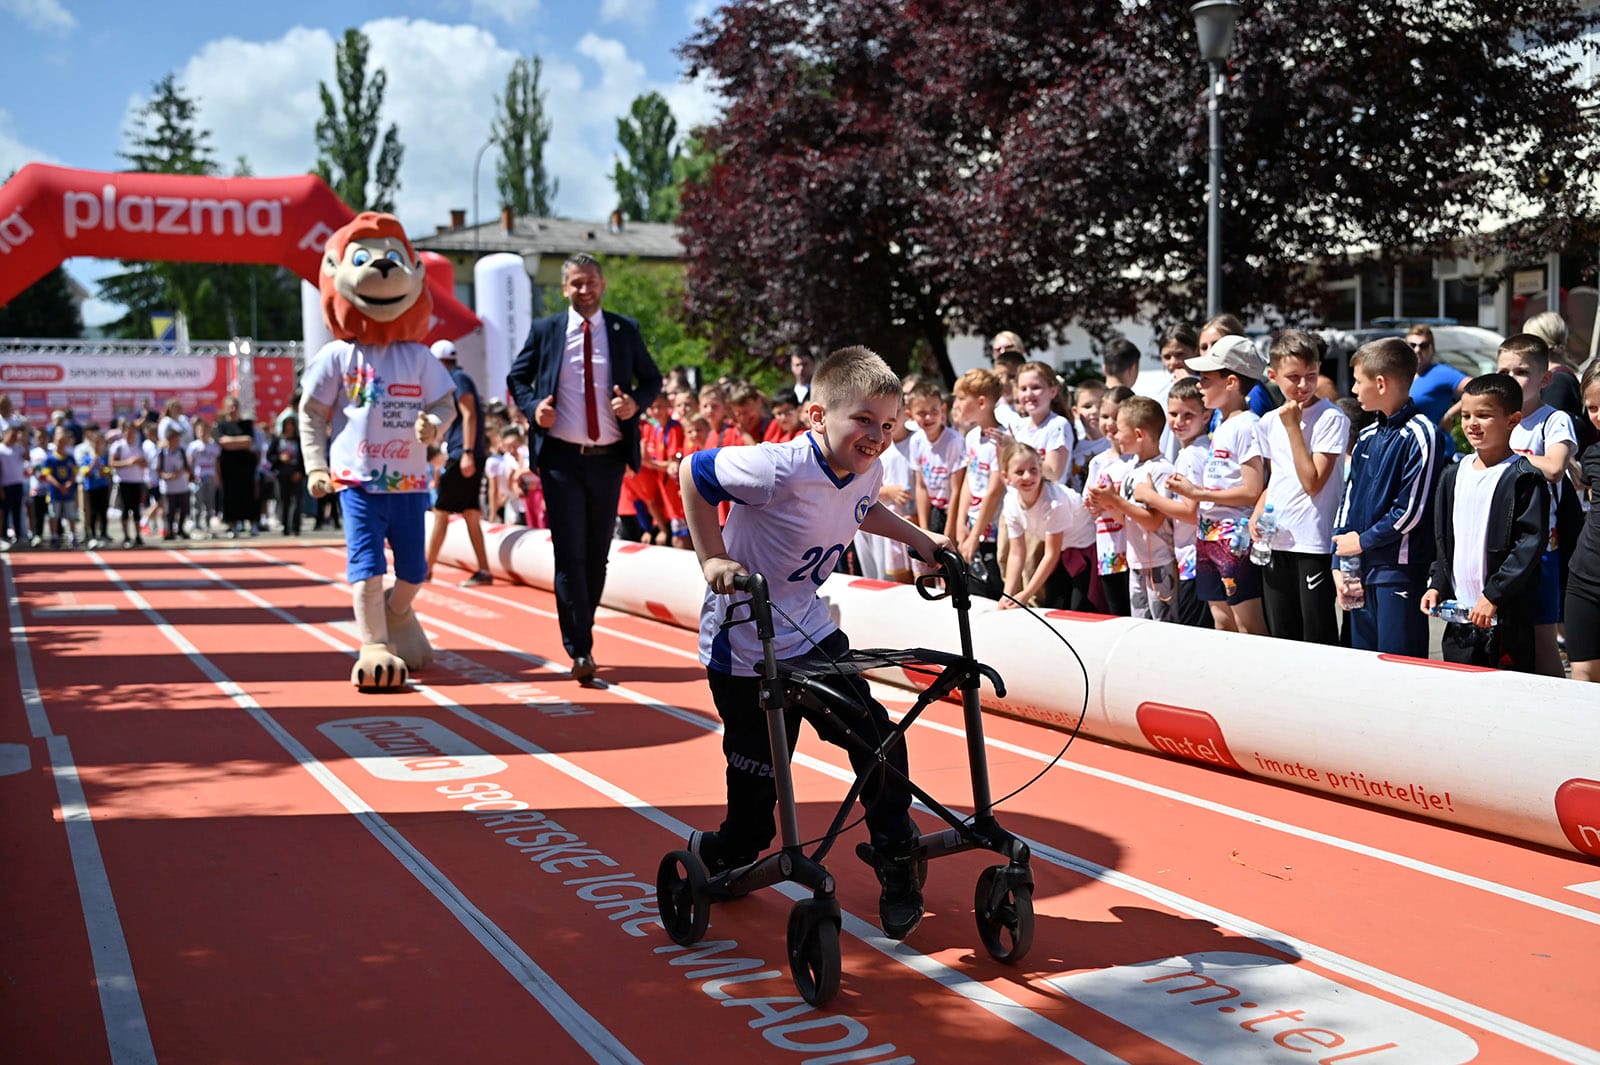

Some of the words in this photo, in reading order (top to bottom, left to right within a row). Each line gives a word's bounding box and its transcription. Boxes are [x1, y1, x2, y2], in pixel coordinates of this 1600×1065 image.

[63, 184, 283, 239] plazma
[787, 544, 845, 586] 20
[331, 720, 465, 772] plazma
[729, 752, 760, 774] JUST
[1153, 734, 1230, 765] m:tel
[1254, 752, 1320, 782] imate
[1326, 771, 1454, 812] prijatelje!
[436, 782, 620, 873] SPORTSKE
[653, 940, 916, 1065] MLADI
[1142, 971, 1399, 1065] m:tel
